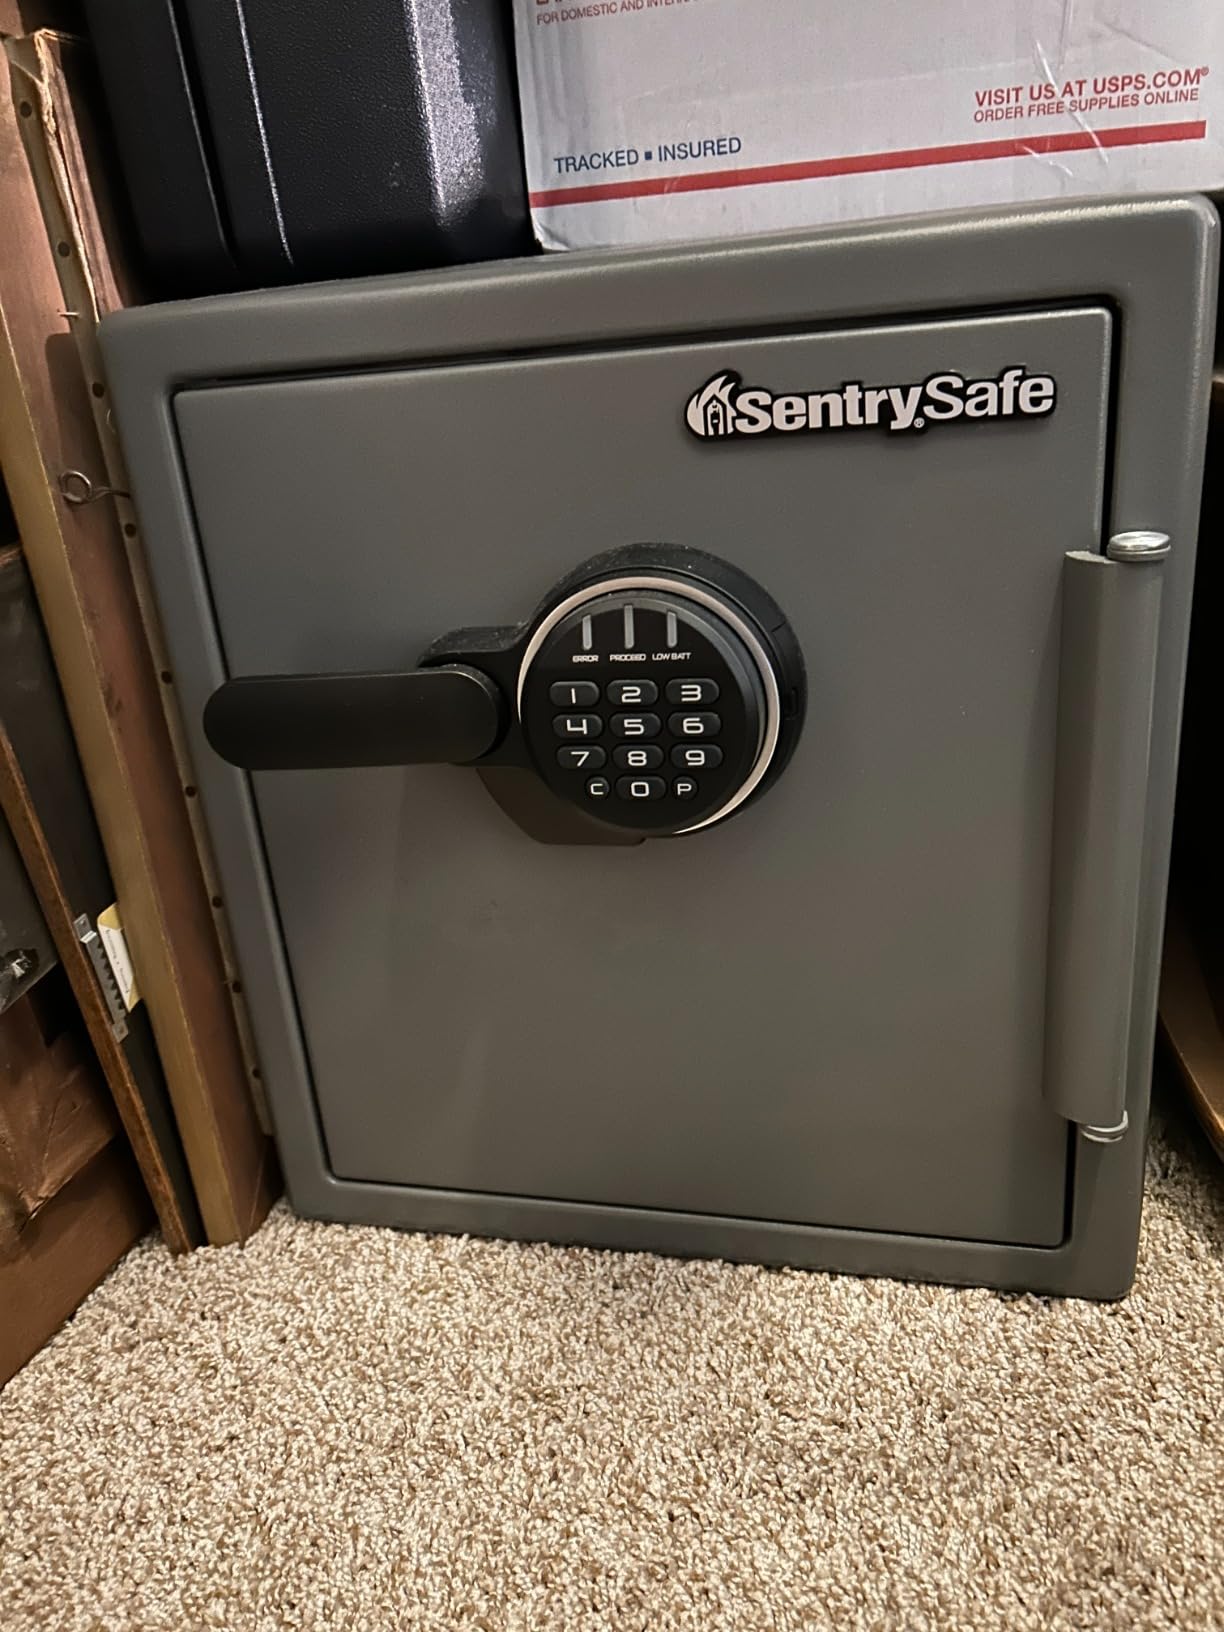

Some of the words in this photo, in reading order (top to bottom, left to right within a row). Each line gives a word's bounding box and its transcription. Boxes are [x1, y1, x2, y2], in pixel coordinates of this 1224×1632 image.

[536, 12, 560, 26] FOR
[560, 3, 618, 22] DOMESTIC
[620, 0, 644, 12] AND
[975, 86, 1024, 107] VISIT
[1029, 83, 1056, 101] US
[1061, 79, 1088, 98] AT
[973, 104, 1024, 123] ORDER
[1027, 101, 1065, 118] FREE
[1069, 95, 1140, 113] SUPPLIES
[1144, 88, 1199, 106] ONLINE
[553, 149, 639, 174] TRACKED
[658, 136, 742, 163] INSURED
[572, 655, 599, 663] ERROR
[609, 653, 647, 662] PROCEED
[651, 653, 671, 661] LOW
[671, 652, 692, 660] BATT
[621, 686, 642, 703] 2
[680, 684, 702, 702] 3
[566, 719, 588, 735] 4
[623, 719, 645, 735] 5
[682, 717, 704, 734] 6
[570, 751, 590, 767] 7
[627, 751, 647, 766] 8
[685, 750, 705, 766] 9
[590, 783, 604, 795] C
[677, 783, 692, 796] P
